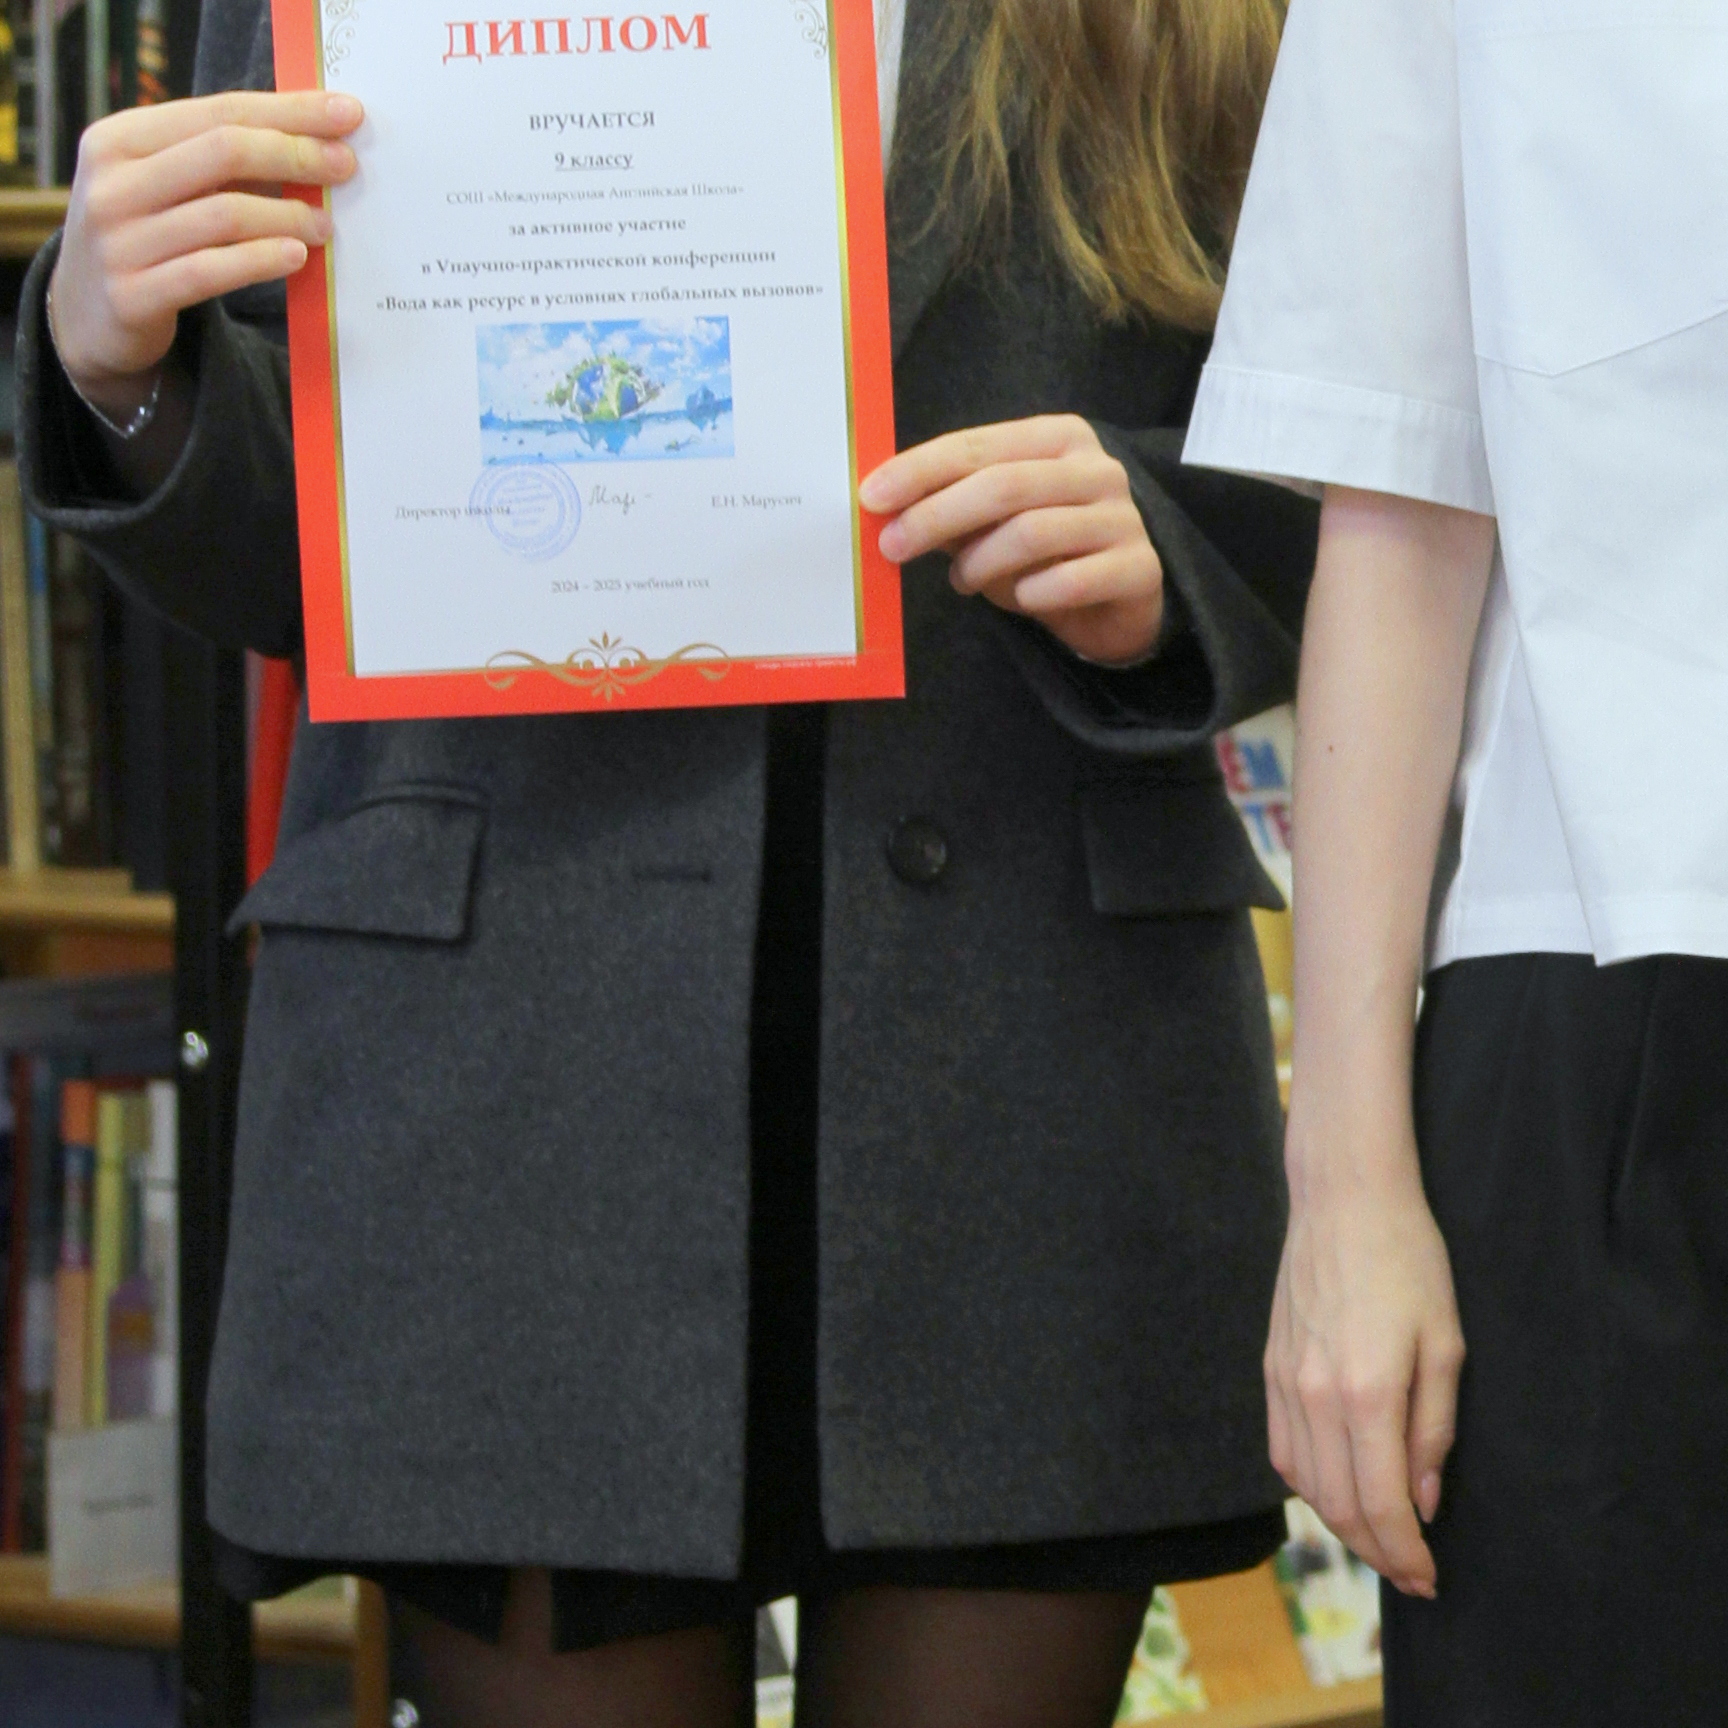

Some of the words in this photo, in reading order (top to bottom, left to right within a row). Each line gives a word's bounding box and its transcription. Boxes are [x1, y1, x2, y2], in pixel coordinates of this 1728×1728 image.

[442, 12, 711, 65] ДИПЛОМ
[529, 111, 655, 132] ВРУЧАЕТСЯ
[553, 151, 567, 169] 9
[570, 154, 633, 171] классу
[445, 190, 484, 205] СОШ
[510, 225, 526, 236] за
[530, 222, 613, 236] активное
[617, 219, 686, 236] участие
[421, 264, 431, 274] в
[651, 249, 776, 270] конференции
[432, 298, 463, 309] как
[467, 296, 525, 313] ресурс
[530, 295, 540, 306] в
[544, 292, 626, 309] условиях
[630, 286, 737, 303] глобальных
[395, 506, 462, 522] Директор
